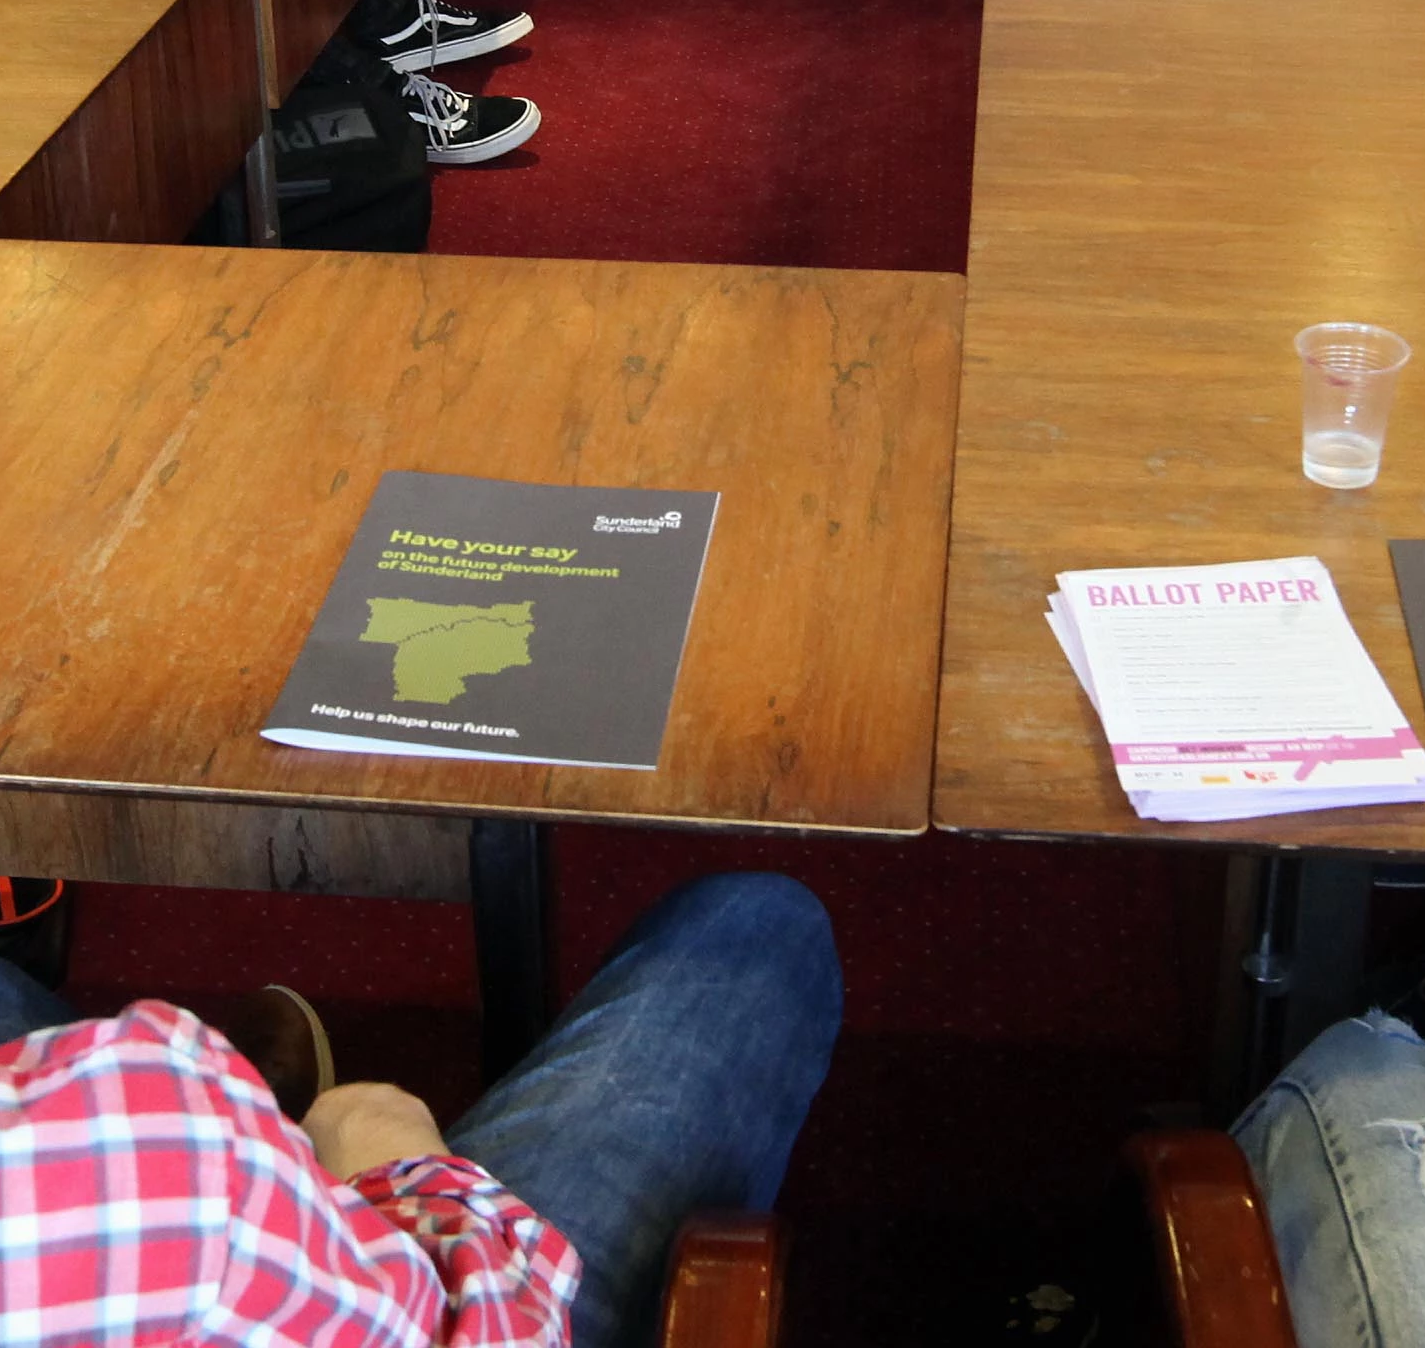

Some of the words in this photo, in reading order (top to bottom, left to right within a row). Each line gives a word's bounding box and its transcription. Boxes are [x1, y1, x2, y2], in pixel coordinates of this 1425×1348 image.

[593, 524, 615, 534] City
[616, 524, 660, 534] Council
[595, 513, 682, 529] Sunderland
[390, 529, 459, 551] Have
[462, 537, 526, 559] your
[530, 545, 579, 563] say
[378, 559, 400, 571] of
[399, 560, 504, 582] Sunderland
[382, 550, 406, 561] on
[409, 550, 439, 564] the
[442, 553, 498, 571] future
[500, 560, 620, 579] development
[1086, 583, 1203, 608] BALLOT
[1216, 578, 1322, 605] PAPER
[310, 703, 351, 720] Help
[354, 709, 376, 722] us
[377, 712, 430, 731] shape
[431, 718, 462, 733] our
[463, 721, 521, 739] future.
